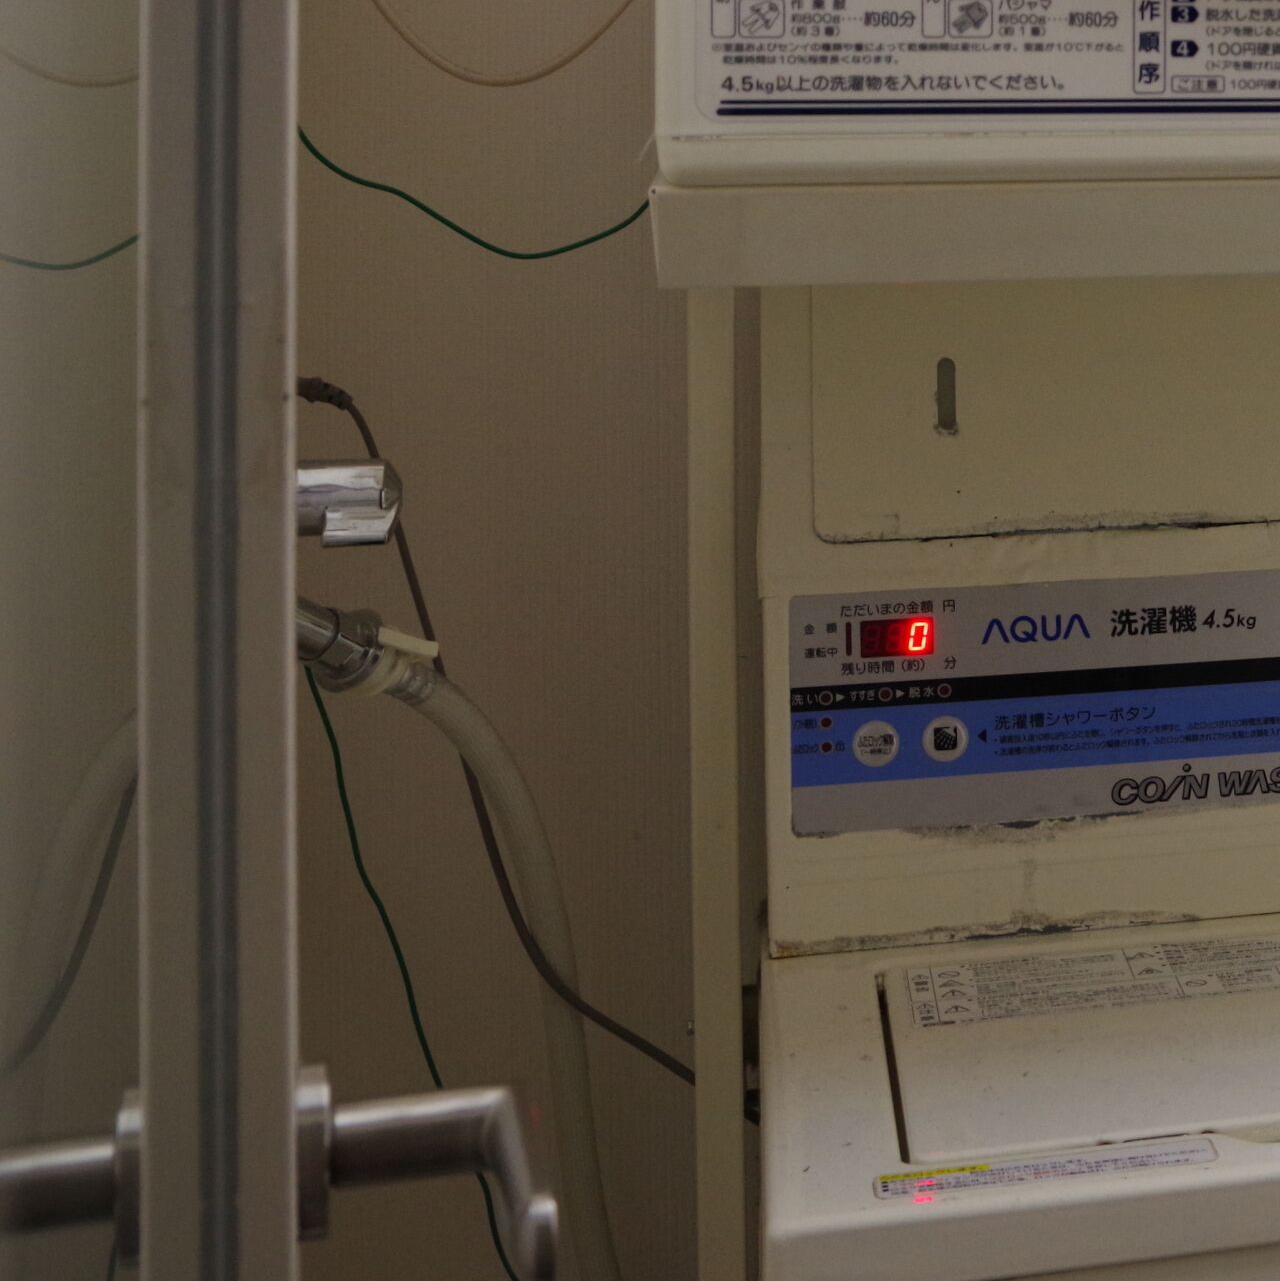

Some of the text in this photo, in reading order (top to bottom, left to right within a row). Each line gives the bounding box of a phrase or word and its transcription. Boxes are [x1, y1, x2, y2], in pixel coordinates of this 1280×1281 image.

[864, 11, 916, 28] 約60分
[1068, 12, 1118, 29] 約60分
[840, 599, 956, 617] ただいまの金額 円
[982, 614, 1091, 646] AQUA
[1111, 605, 1197, 637] 洗濯機
[1202, 608, 1257, 630] 4.5kg
[908, 622, 928, 651] 0
[944, 657, 957, 670] 分
